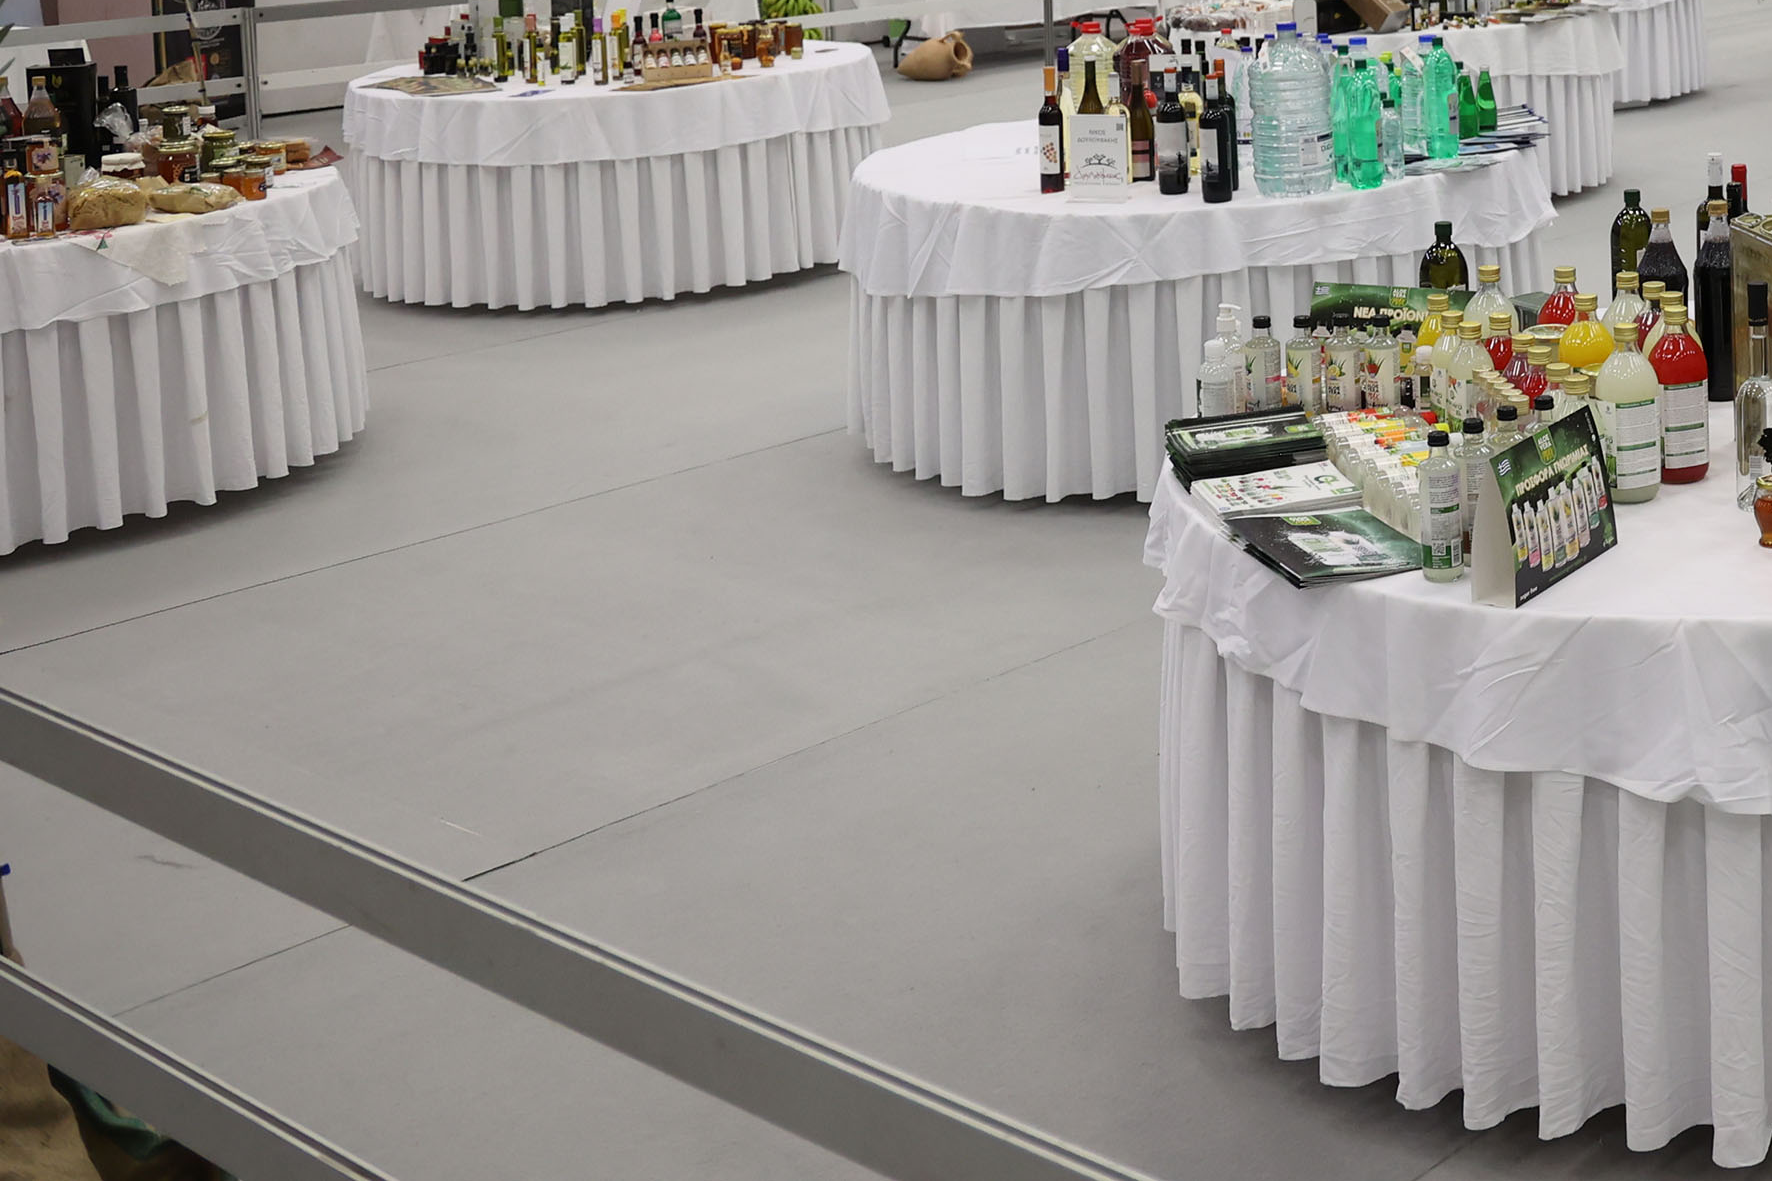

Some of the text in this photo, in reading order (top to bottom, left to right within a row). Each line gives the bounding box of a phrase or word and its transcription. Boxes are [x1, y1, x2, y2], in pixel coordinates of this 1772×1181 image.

[1353, 306, 1429, 321] ΝΕΑ ΠΡΟΪΟΝ
[1515, 464, 1556, 497] ΠΡΟΣΦΟΡΑ
